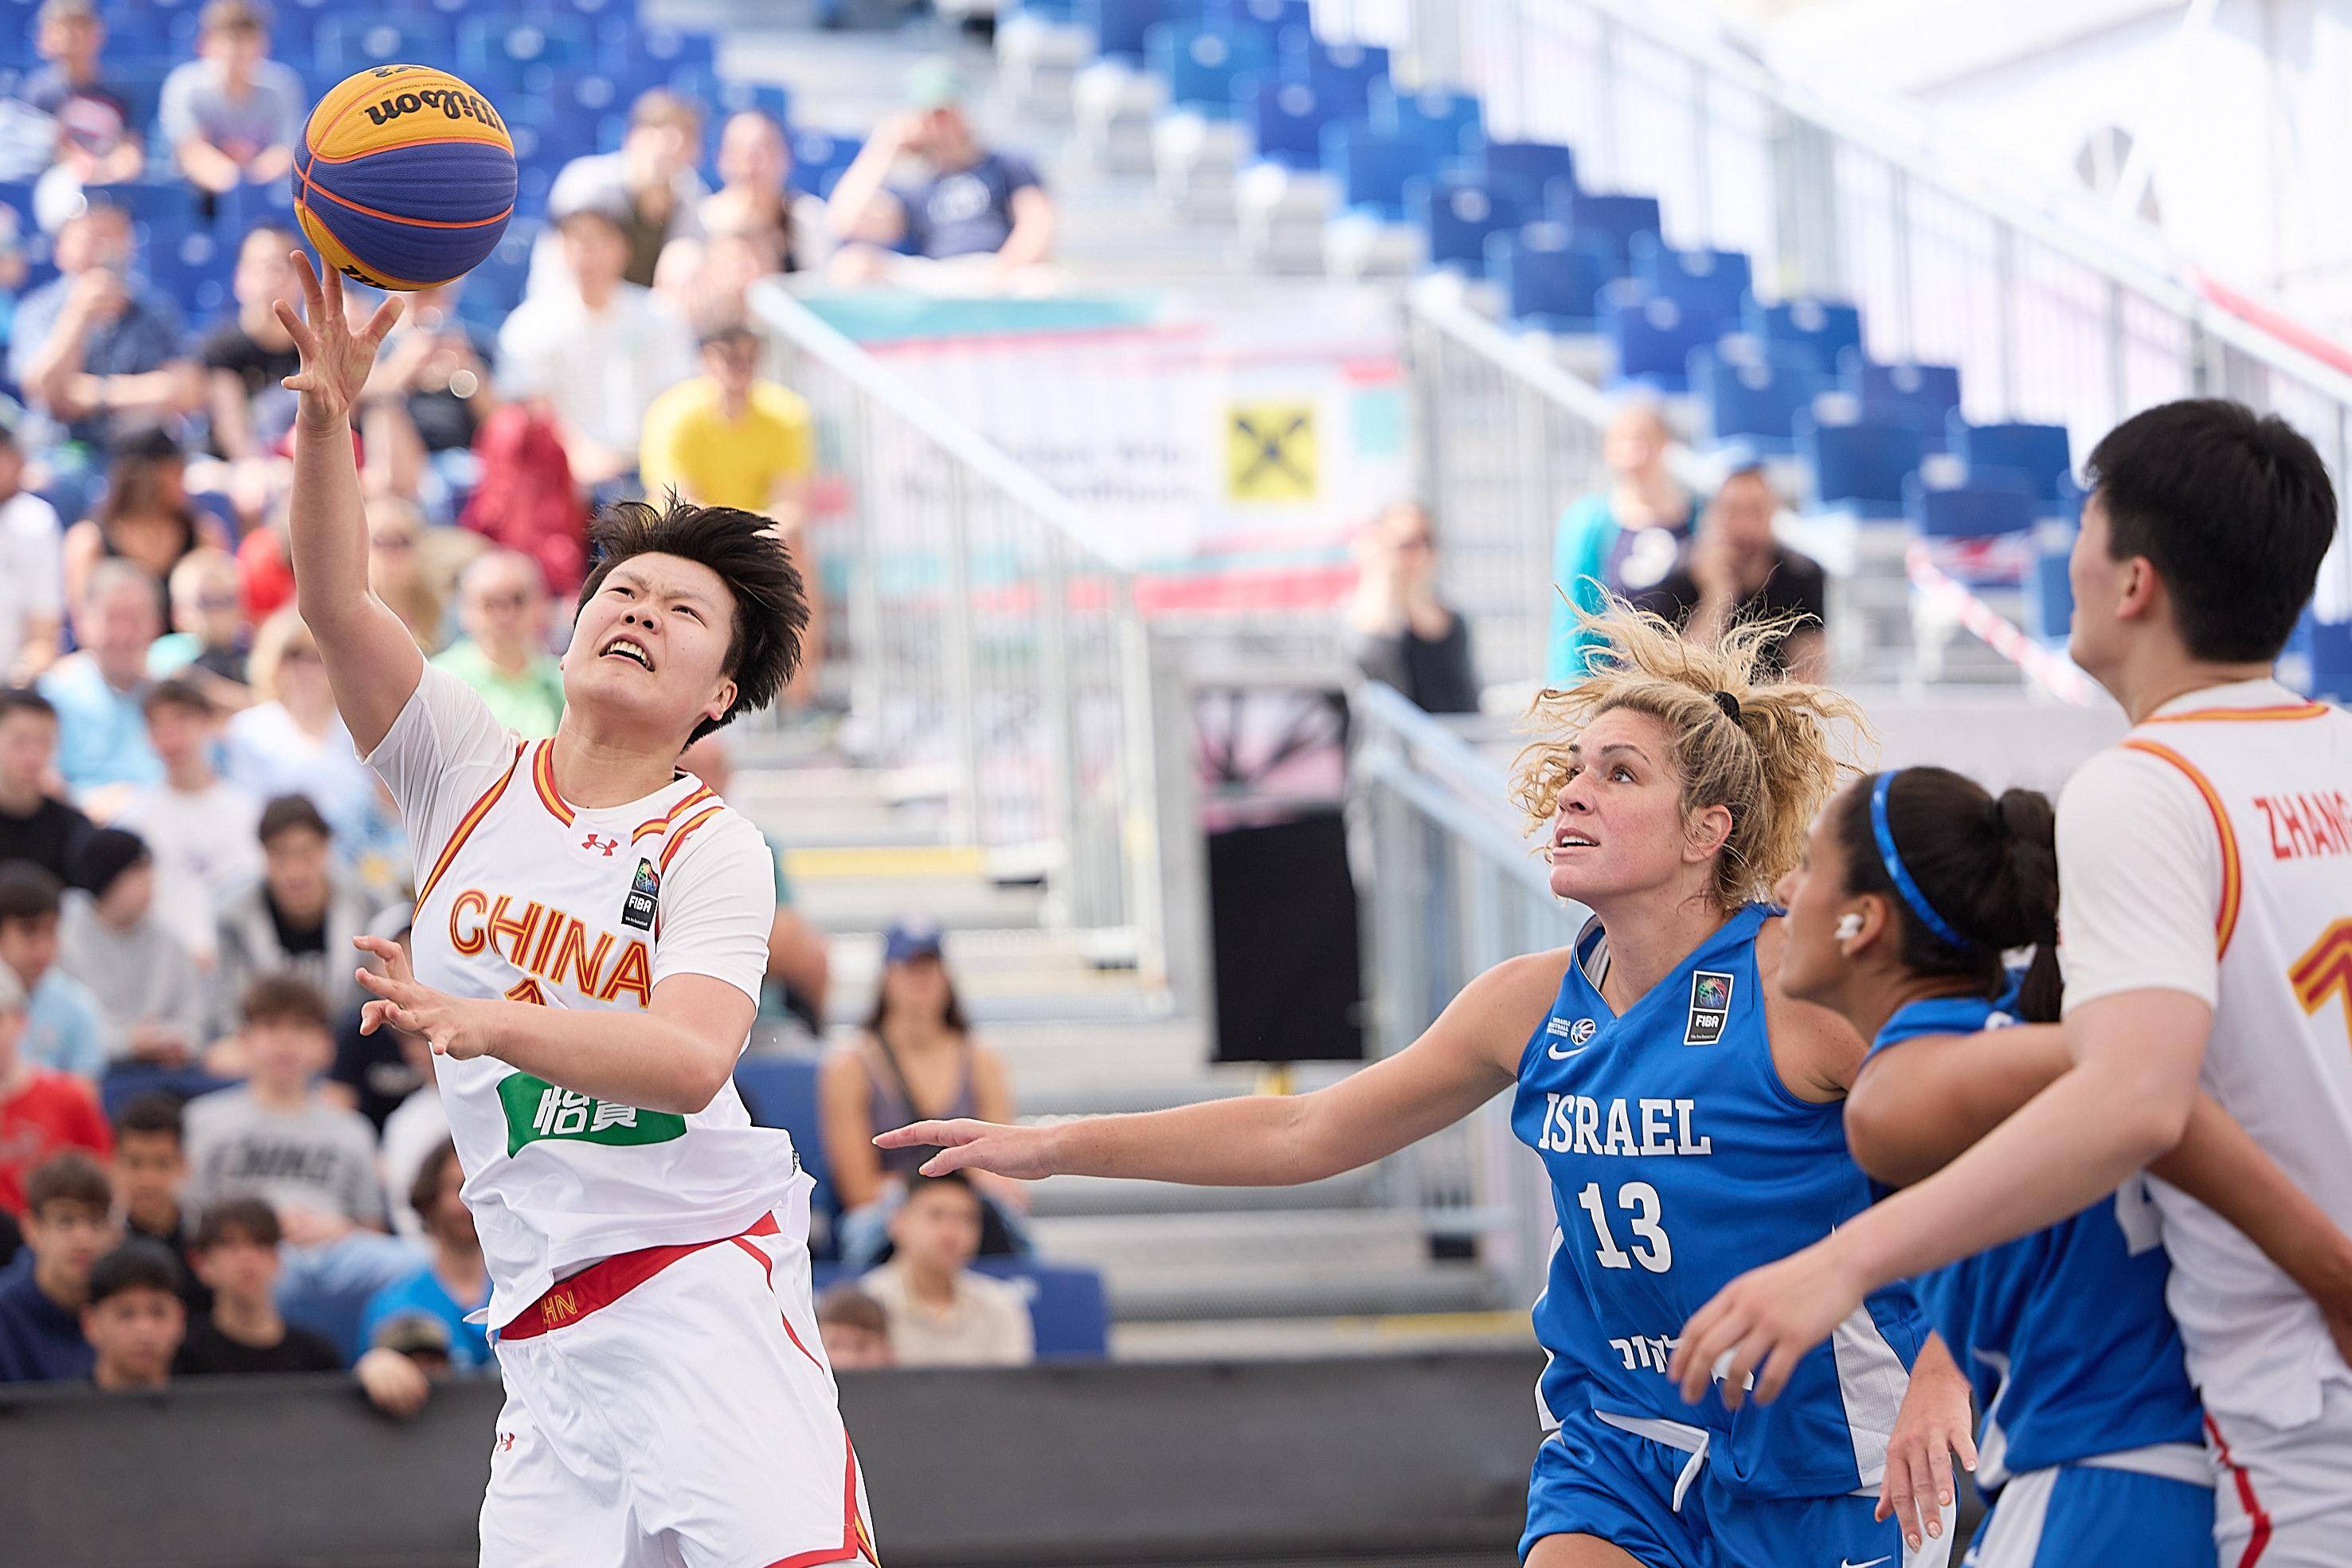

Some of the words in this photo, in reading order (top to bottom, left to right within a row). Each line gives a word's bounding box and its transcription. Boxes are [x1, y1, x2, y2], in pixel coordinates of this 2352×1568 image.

[364, 89, 505, 135] Wilson
[628, 895, 652, 913] FIBA
[448, 888, 652, 1009] CHINA
[1695, 1015, 1720, 1028] FIBA
[1538, 1092, 1712, 1155] ISRAEL
[1578, 1181, 1672, 1273] 13
